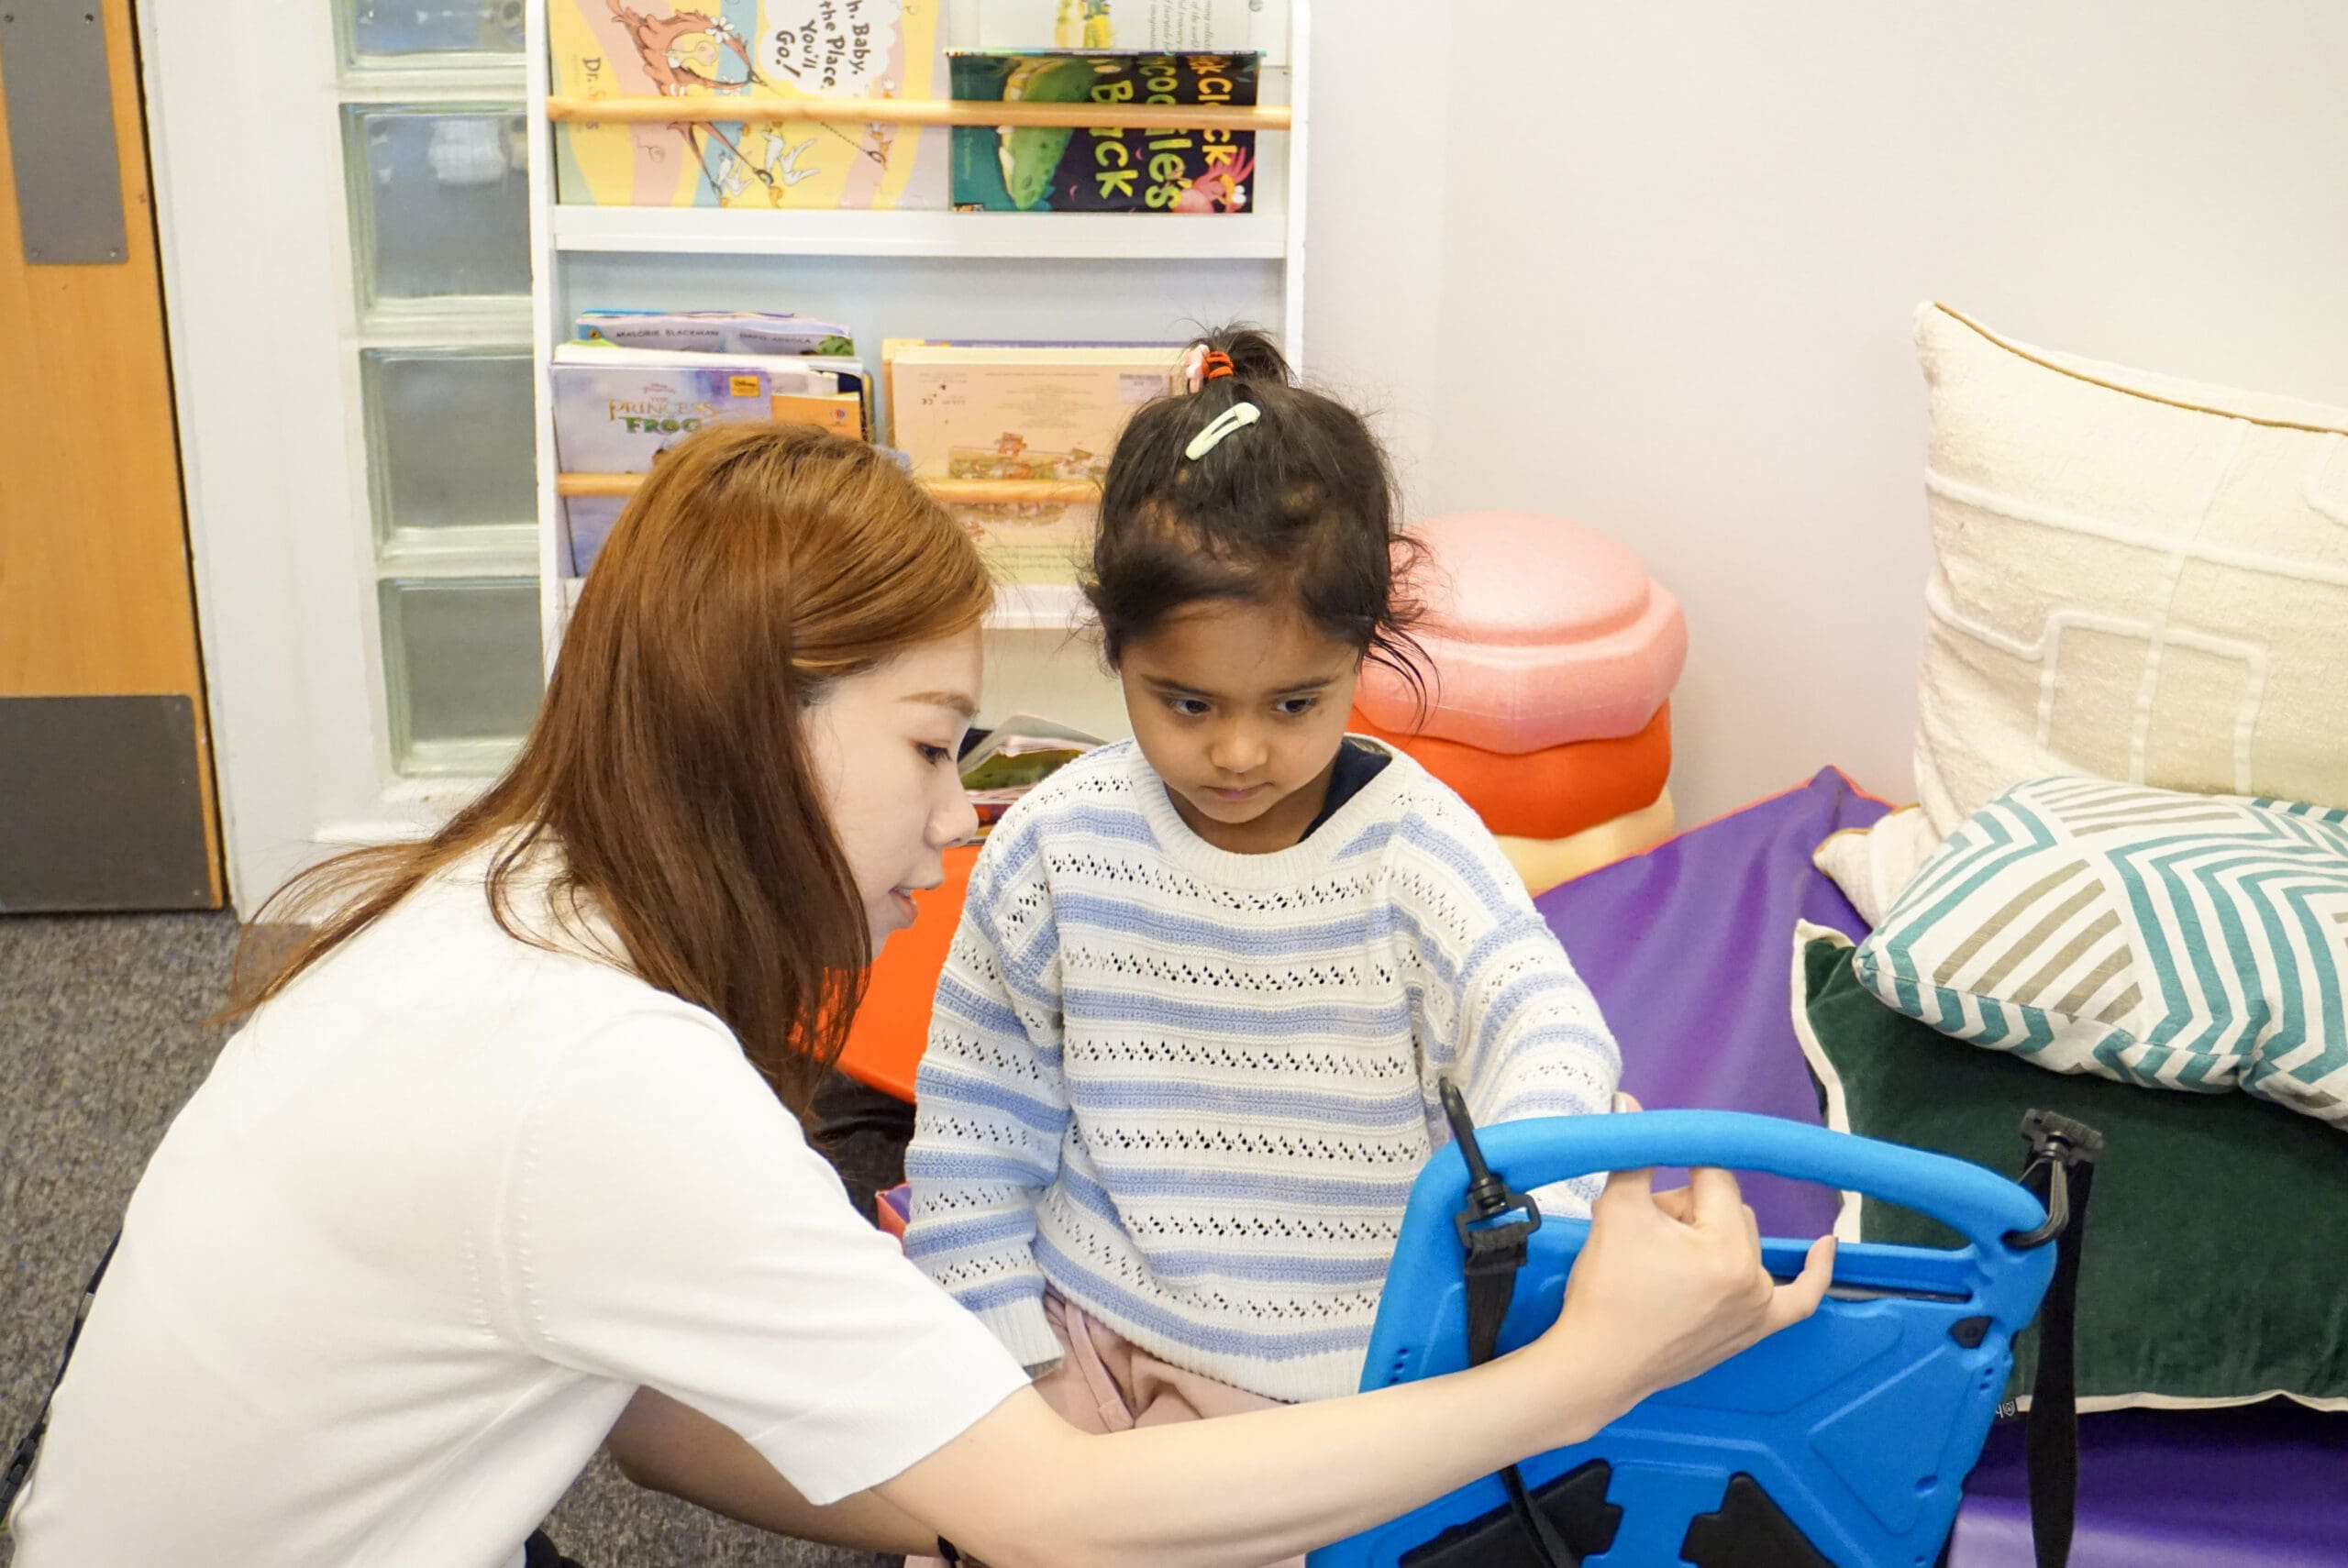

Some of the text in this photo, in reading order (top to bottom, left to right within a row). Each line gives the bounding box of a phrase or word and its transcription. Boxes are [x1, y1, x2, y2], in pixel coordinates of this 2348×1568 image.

[819, 0, 836, 31] the
[776, 30, 802, 78] Go!
[800, 18, 819, 69] You'll
[581, 56, 602, 83] Dr.
[1198, 77, 1238, 166] Clck
